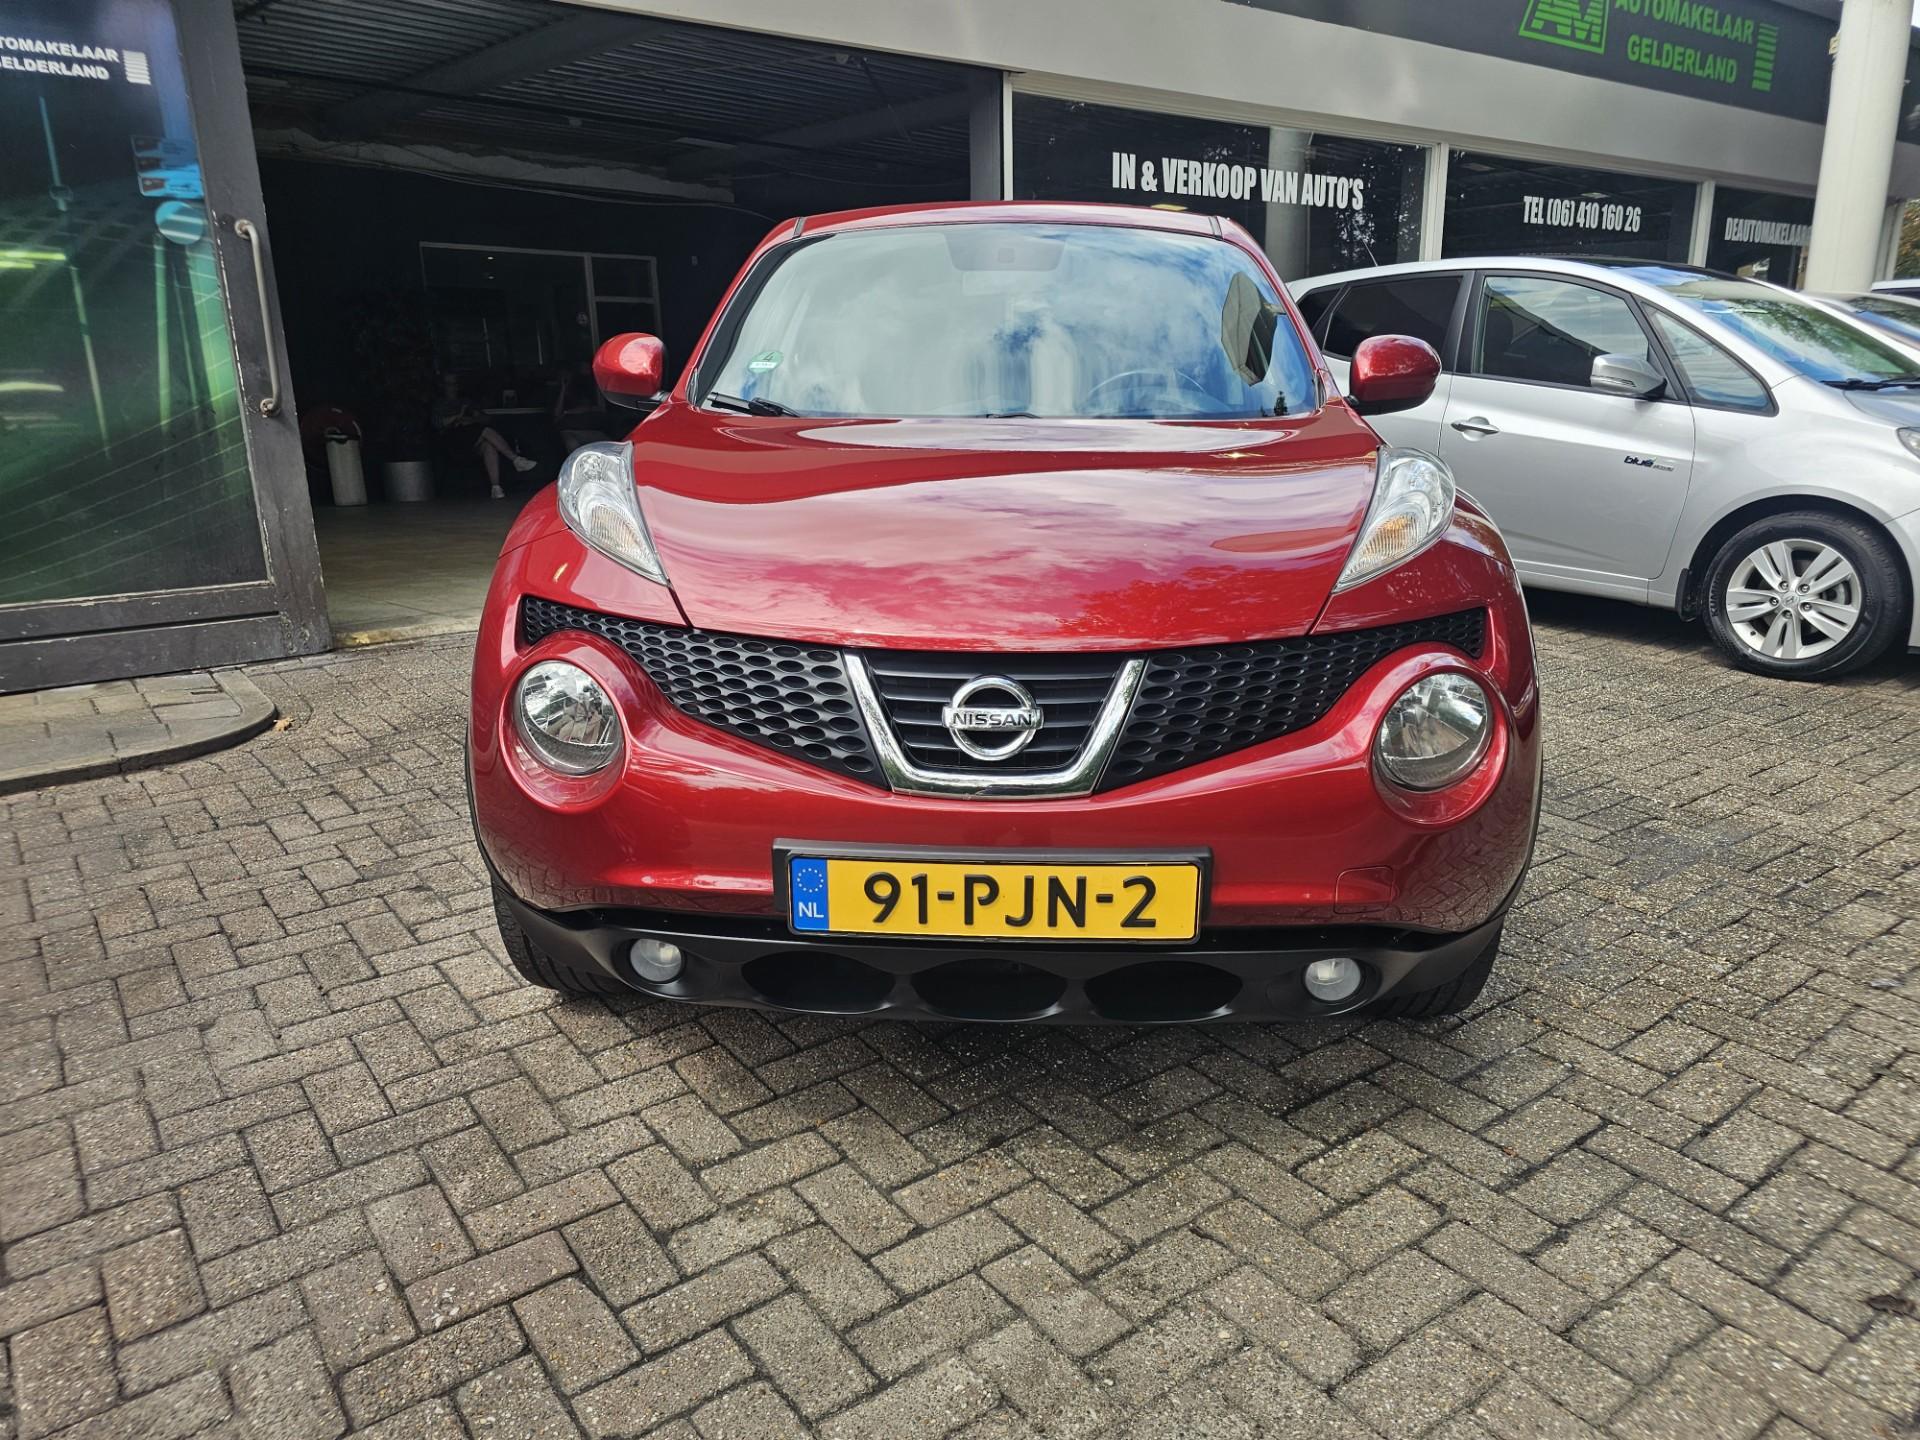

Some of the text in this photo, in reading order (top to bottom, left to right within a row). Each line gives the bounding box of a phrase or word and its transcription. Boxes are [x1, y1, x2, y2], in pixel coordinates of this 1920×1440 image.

[0, 56, 110, 80] ELDERLAND
[1627, 34, 1737, 84] GELDERLAND
[1112, 152, 1364, 211] IN & VERKOOP VAN AUTO'S
[1523, 195, 1642, 233] TEL (06) 410 160 26
[952, 712, 1032, 726] NISSAN
[798, 901, 825, 919] NL
[863, 870, 1158, 929] 91-PJN-2
